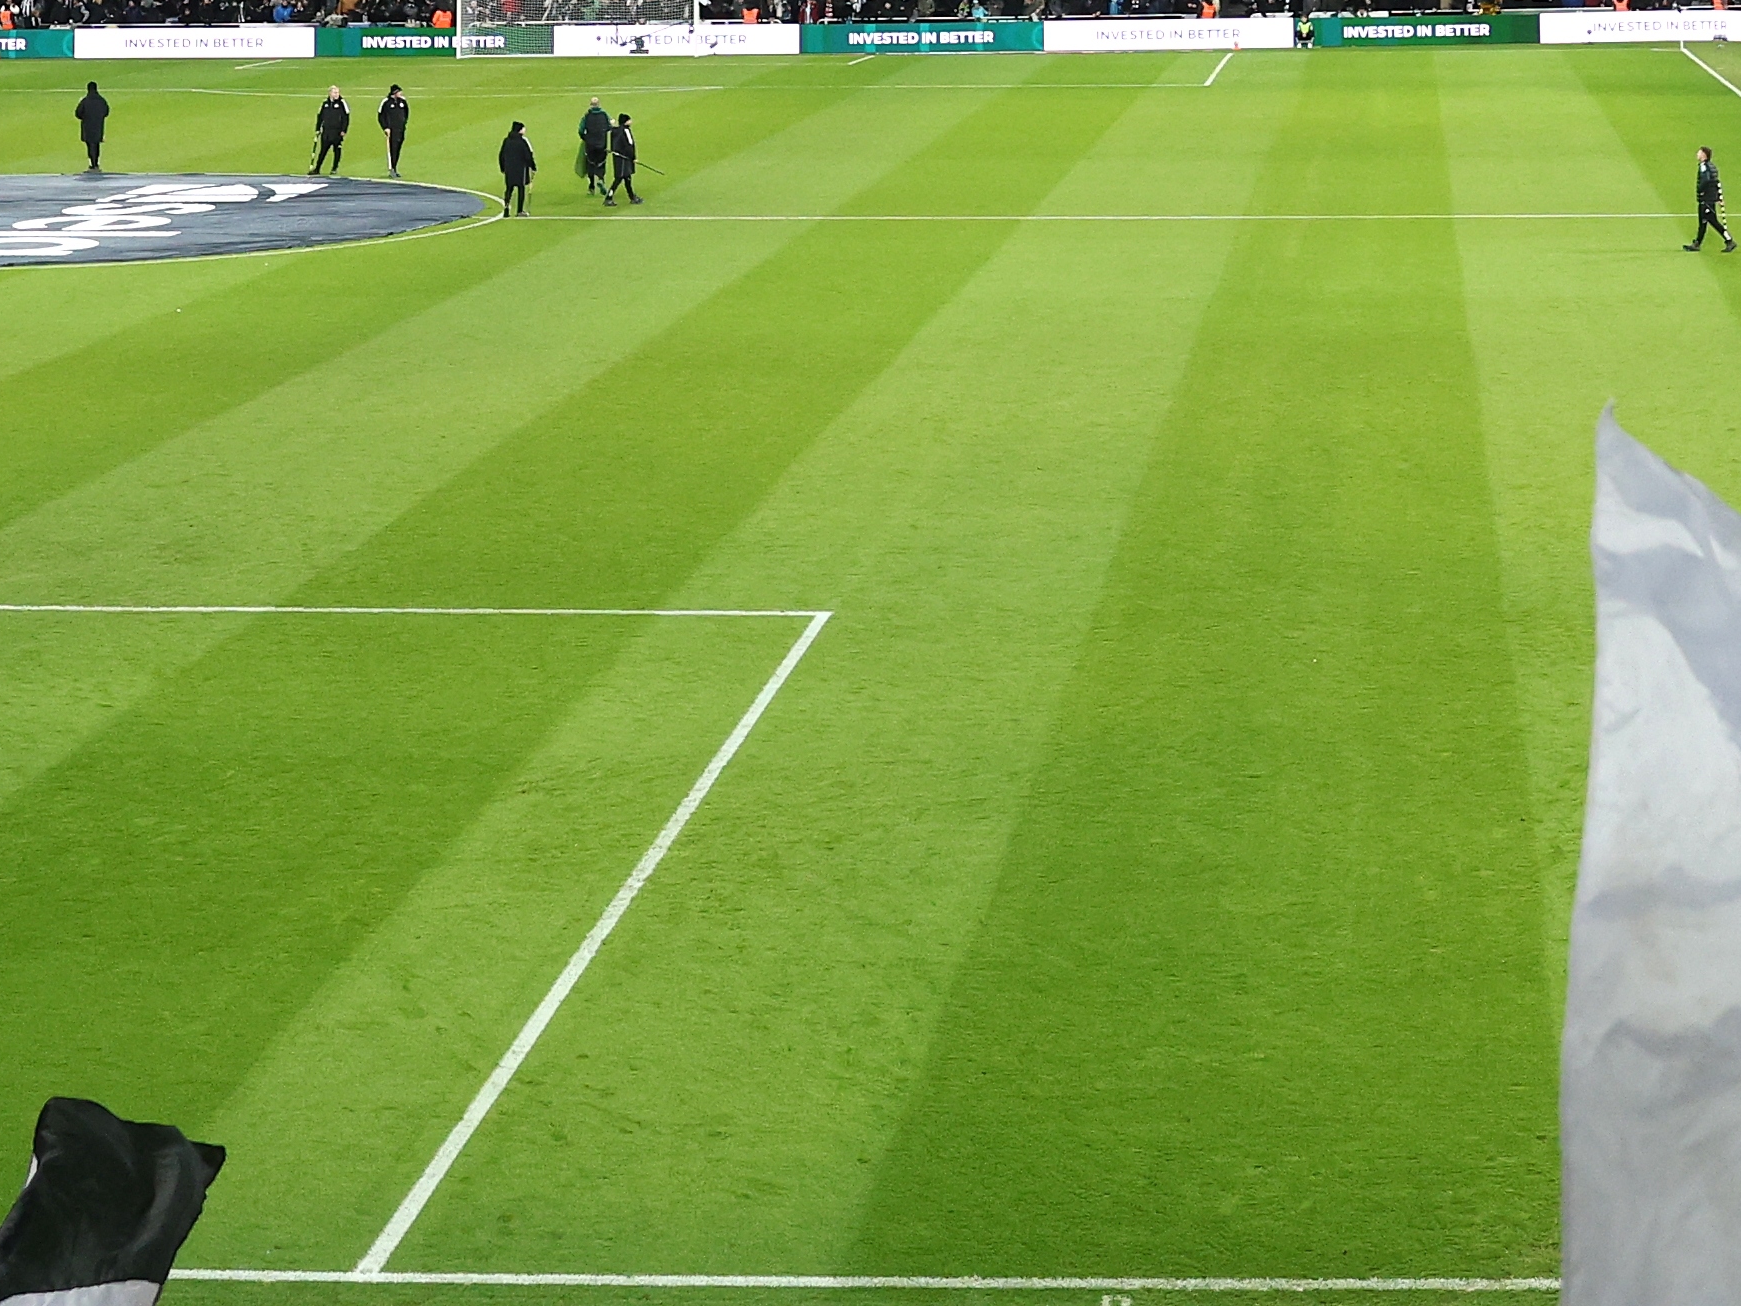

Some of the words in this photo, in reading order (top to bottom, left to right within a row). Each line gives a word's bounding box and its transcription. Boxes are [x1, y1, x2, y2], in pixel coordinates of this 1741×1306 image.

[1343, 25, 1414, 38] INVESTED
[1417, 24, 1432, 37] IN
[1435, 24, 1490, 36] BETTER
[1593, 21, 1662, 32] INVESTED
[1667, 21, 1679, 32] IN
[1683, 21, 1727, 32] BETTER
[849, 32, 919, 45] INVESTED
[921, 32, 937, 44] IN
[940, 31, 994, 44] BETTER
[1096, 30, 1164, 40] INVESTED
[1170, 30, 1183, 39] IN
[1188, 29, 1240, 39] BETTER
[125, 38, 191, 48] INVESTED
[196, 38, 208, 48] IN
[214, 38, 264, 48] BETTER
[362, 36, 432, 48] INVESTED
[434, 36, 449, 48] IN
